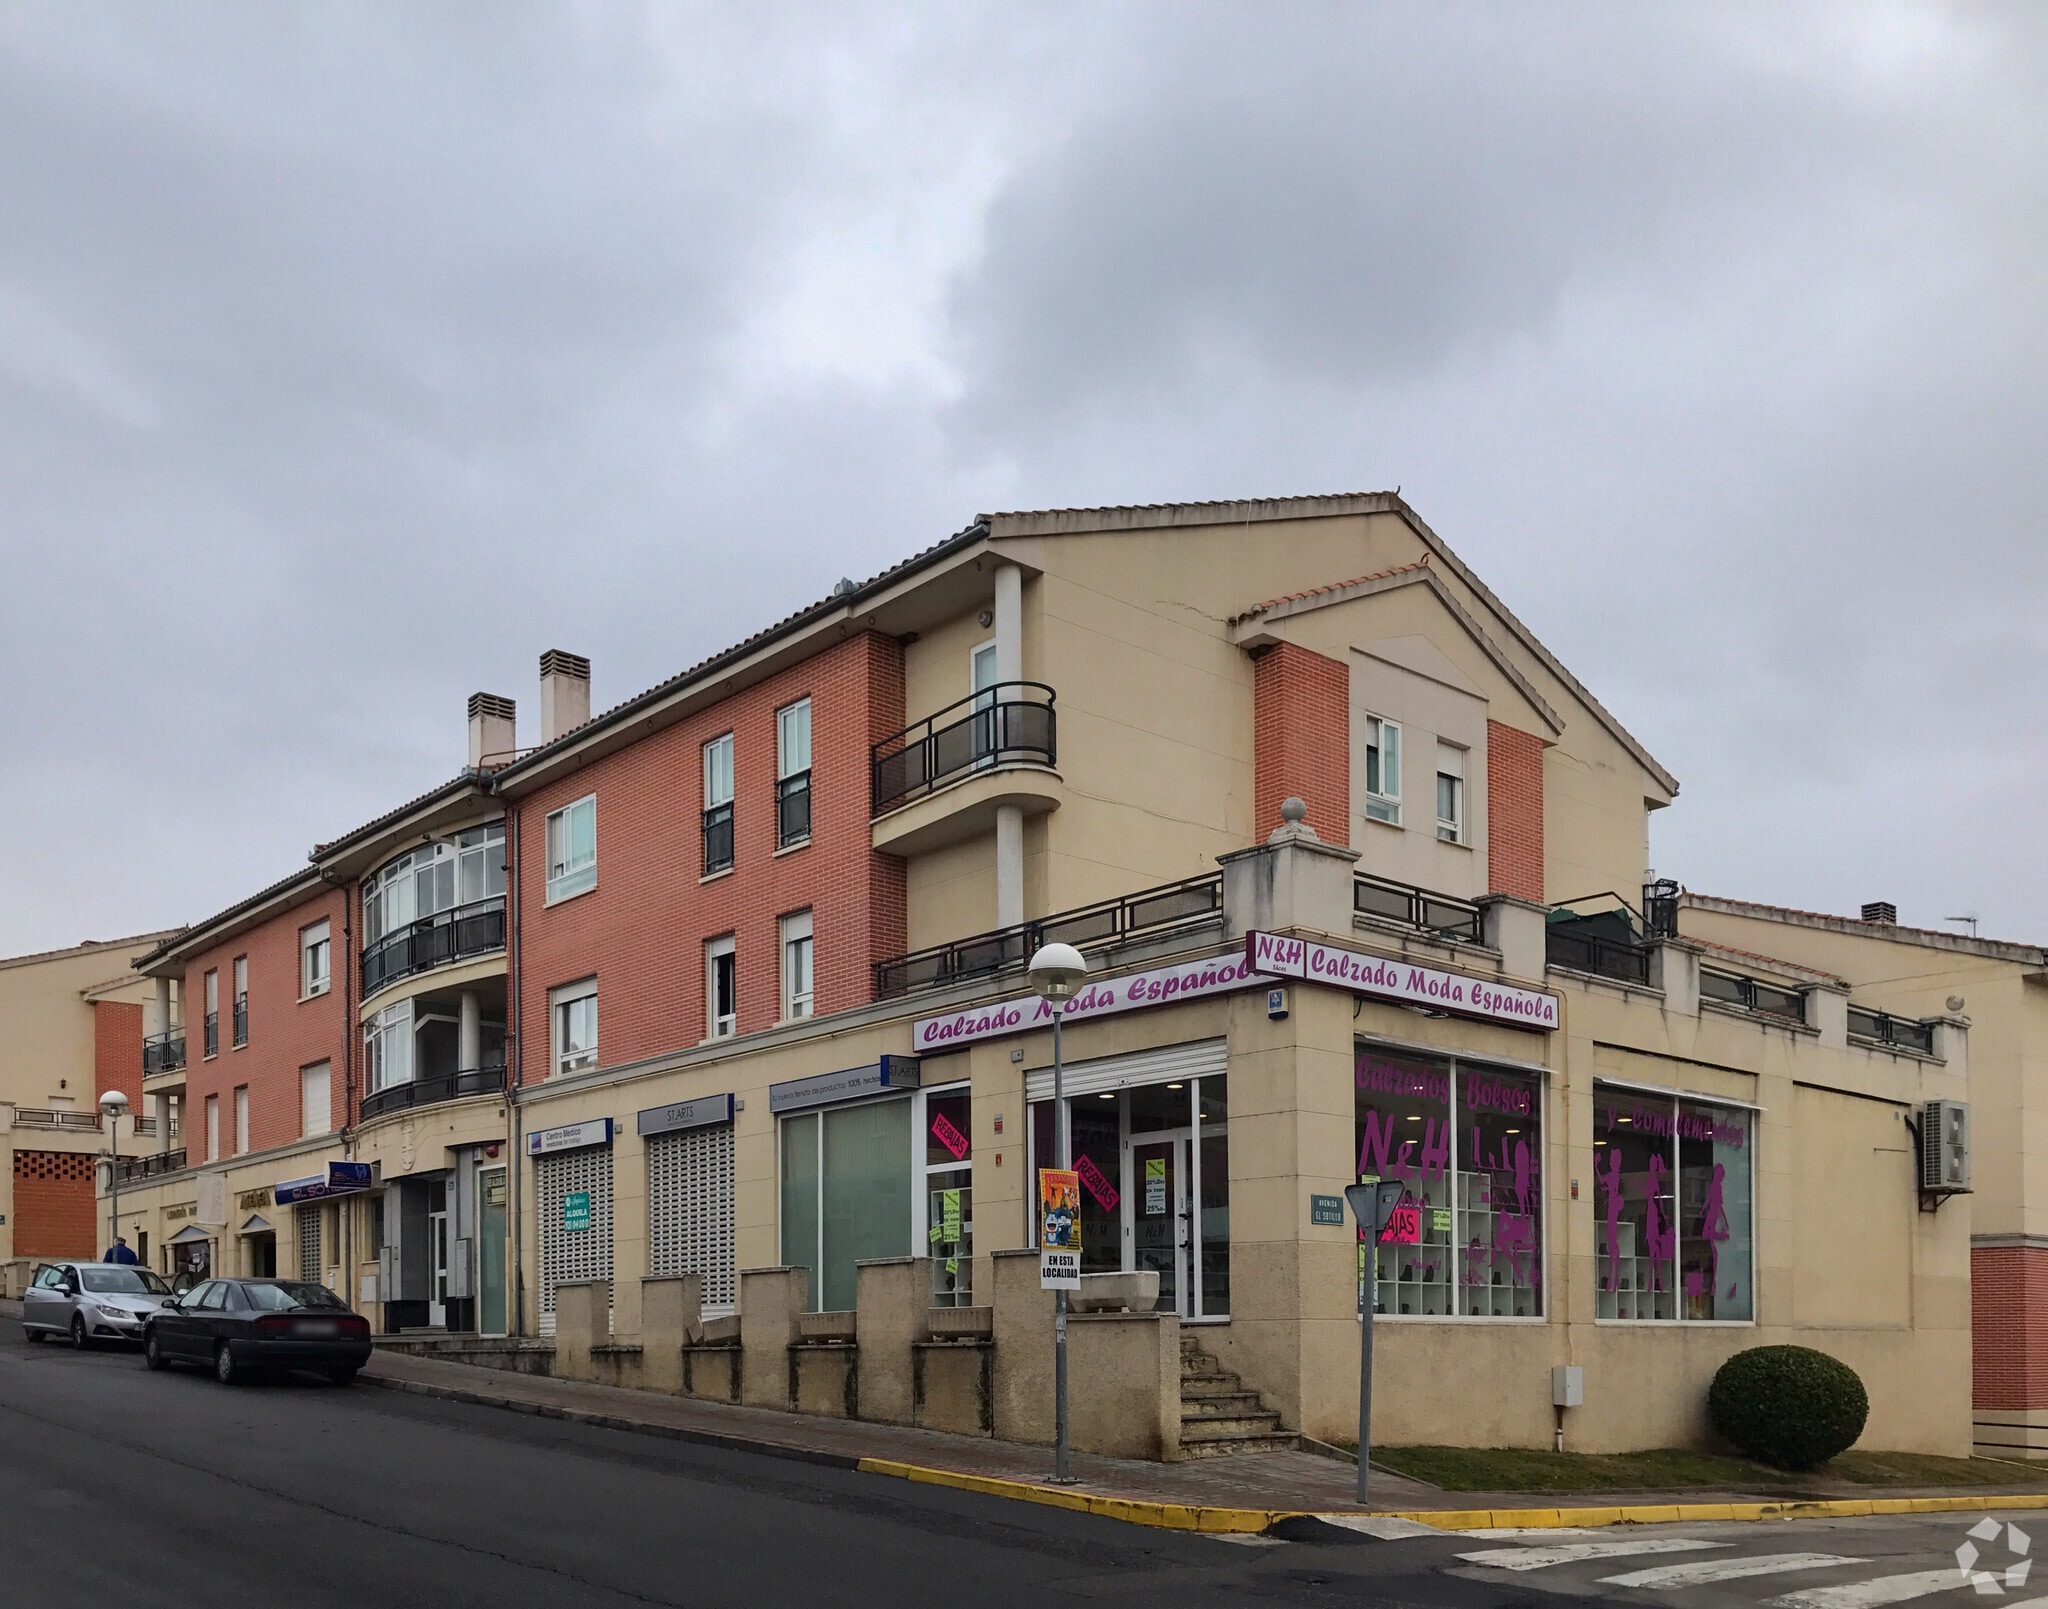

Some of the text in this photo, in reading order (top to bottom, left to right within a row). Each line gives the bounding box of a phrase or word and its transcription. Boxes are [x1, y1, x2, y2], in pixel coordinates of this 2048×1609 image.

[1257, 935, 1302, 965] N&H
[923, 1005, 1021, 1043] Calzado
[1127, 962, 1261, 1002] Español
[1310, 948, 1554, 1021] Calzado Moda Española
[1356, 1055, 1531, 1117] Calzados Bolsos
[667, 1105, 694, 1122] ST.ARTS
[935, 1116, 966, 1154] REBAJAS
[1357, 1110, 1450, 1184] N&H
[1076, 1159, 1116, 1206] REBAJAS
[566, 1208, 588, 1217] ALQUILA
[1043, 1267, 1078, 1279] LOCALIDAD
[1049, 1255, 1074, 1266] EN ESTA
